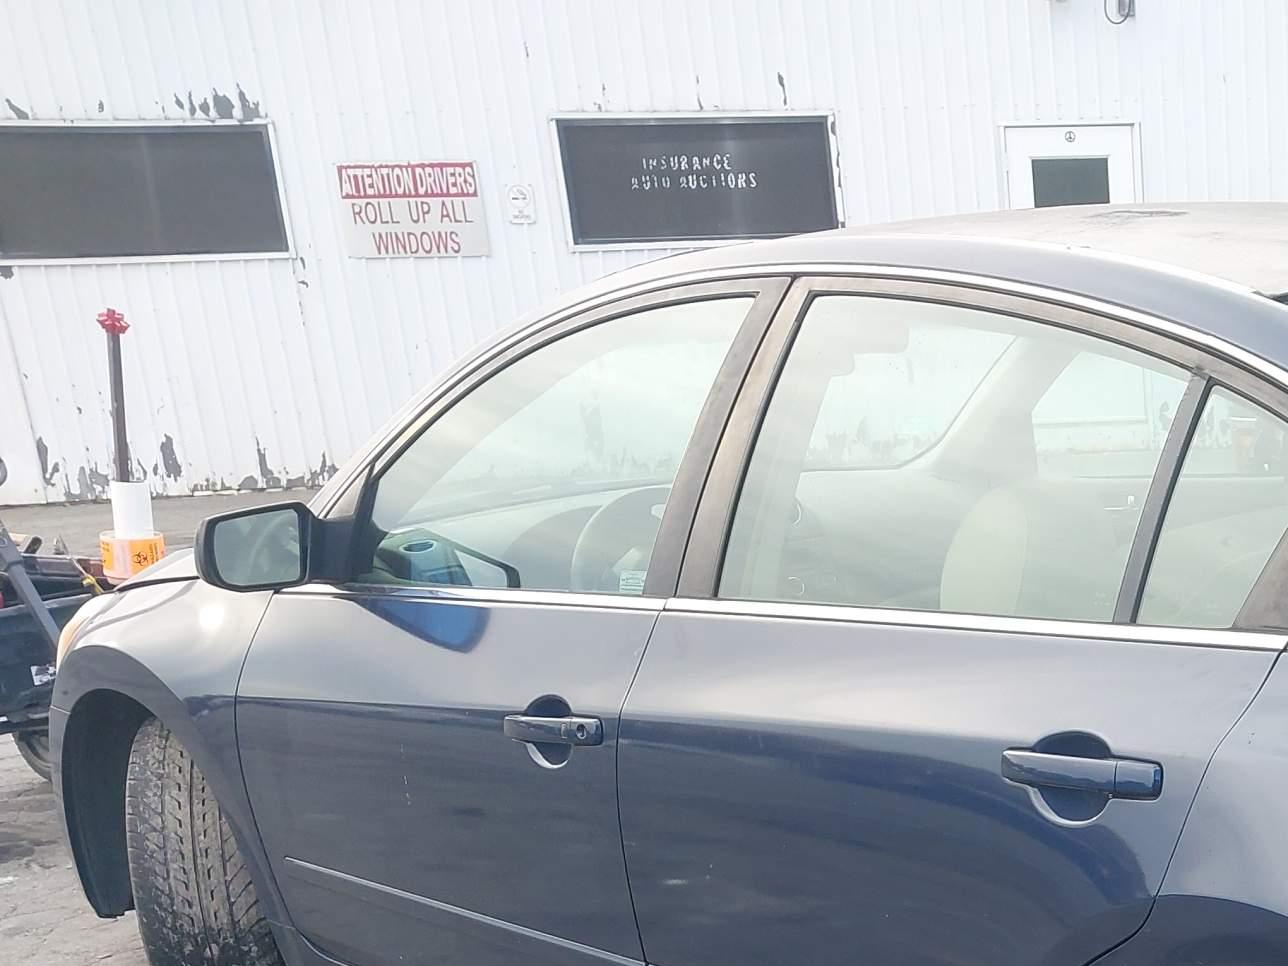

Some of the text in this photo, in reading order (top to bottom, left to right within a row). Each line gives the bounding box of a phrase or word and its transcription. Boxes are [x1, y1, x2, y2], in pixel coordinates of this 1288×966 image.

[642, 153, 732, 170] INSURANCE
[341, 165, 476, 196] ATTENTION DRIVERS
[679, 172, 757, 189] AUCTIONS
[352, 199, 474, 225] ROLL UP ALL
[372, 230, 462, 255] WINDOWS
